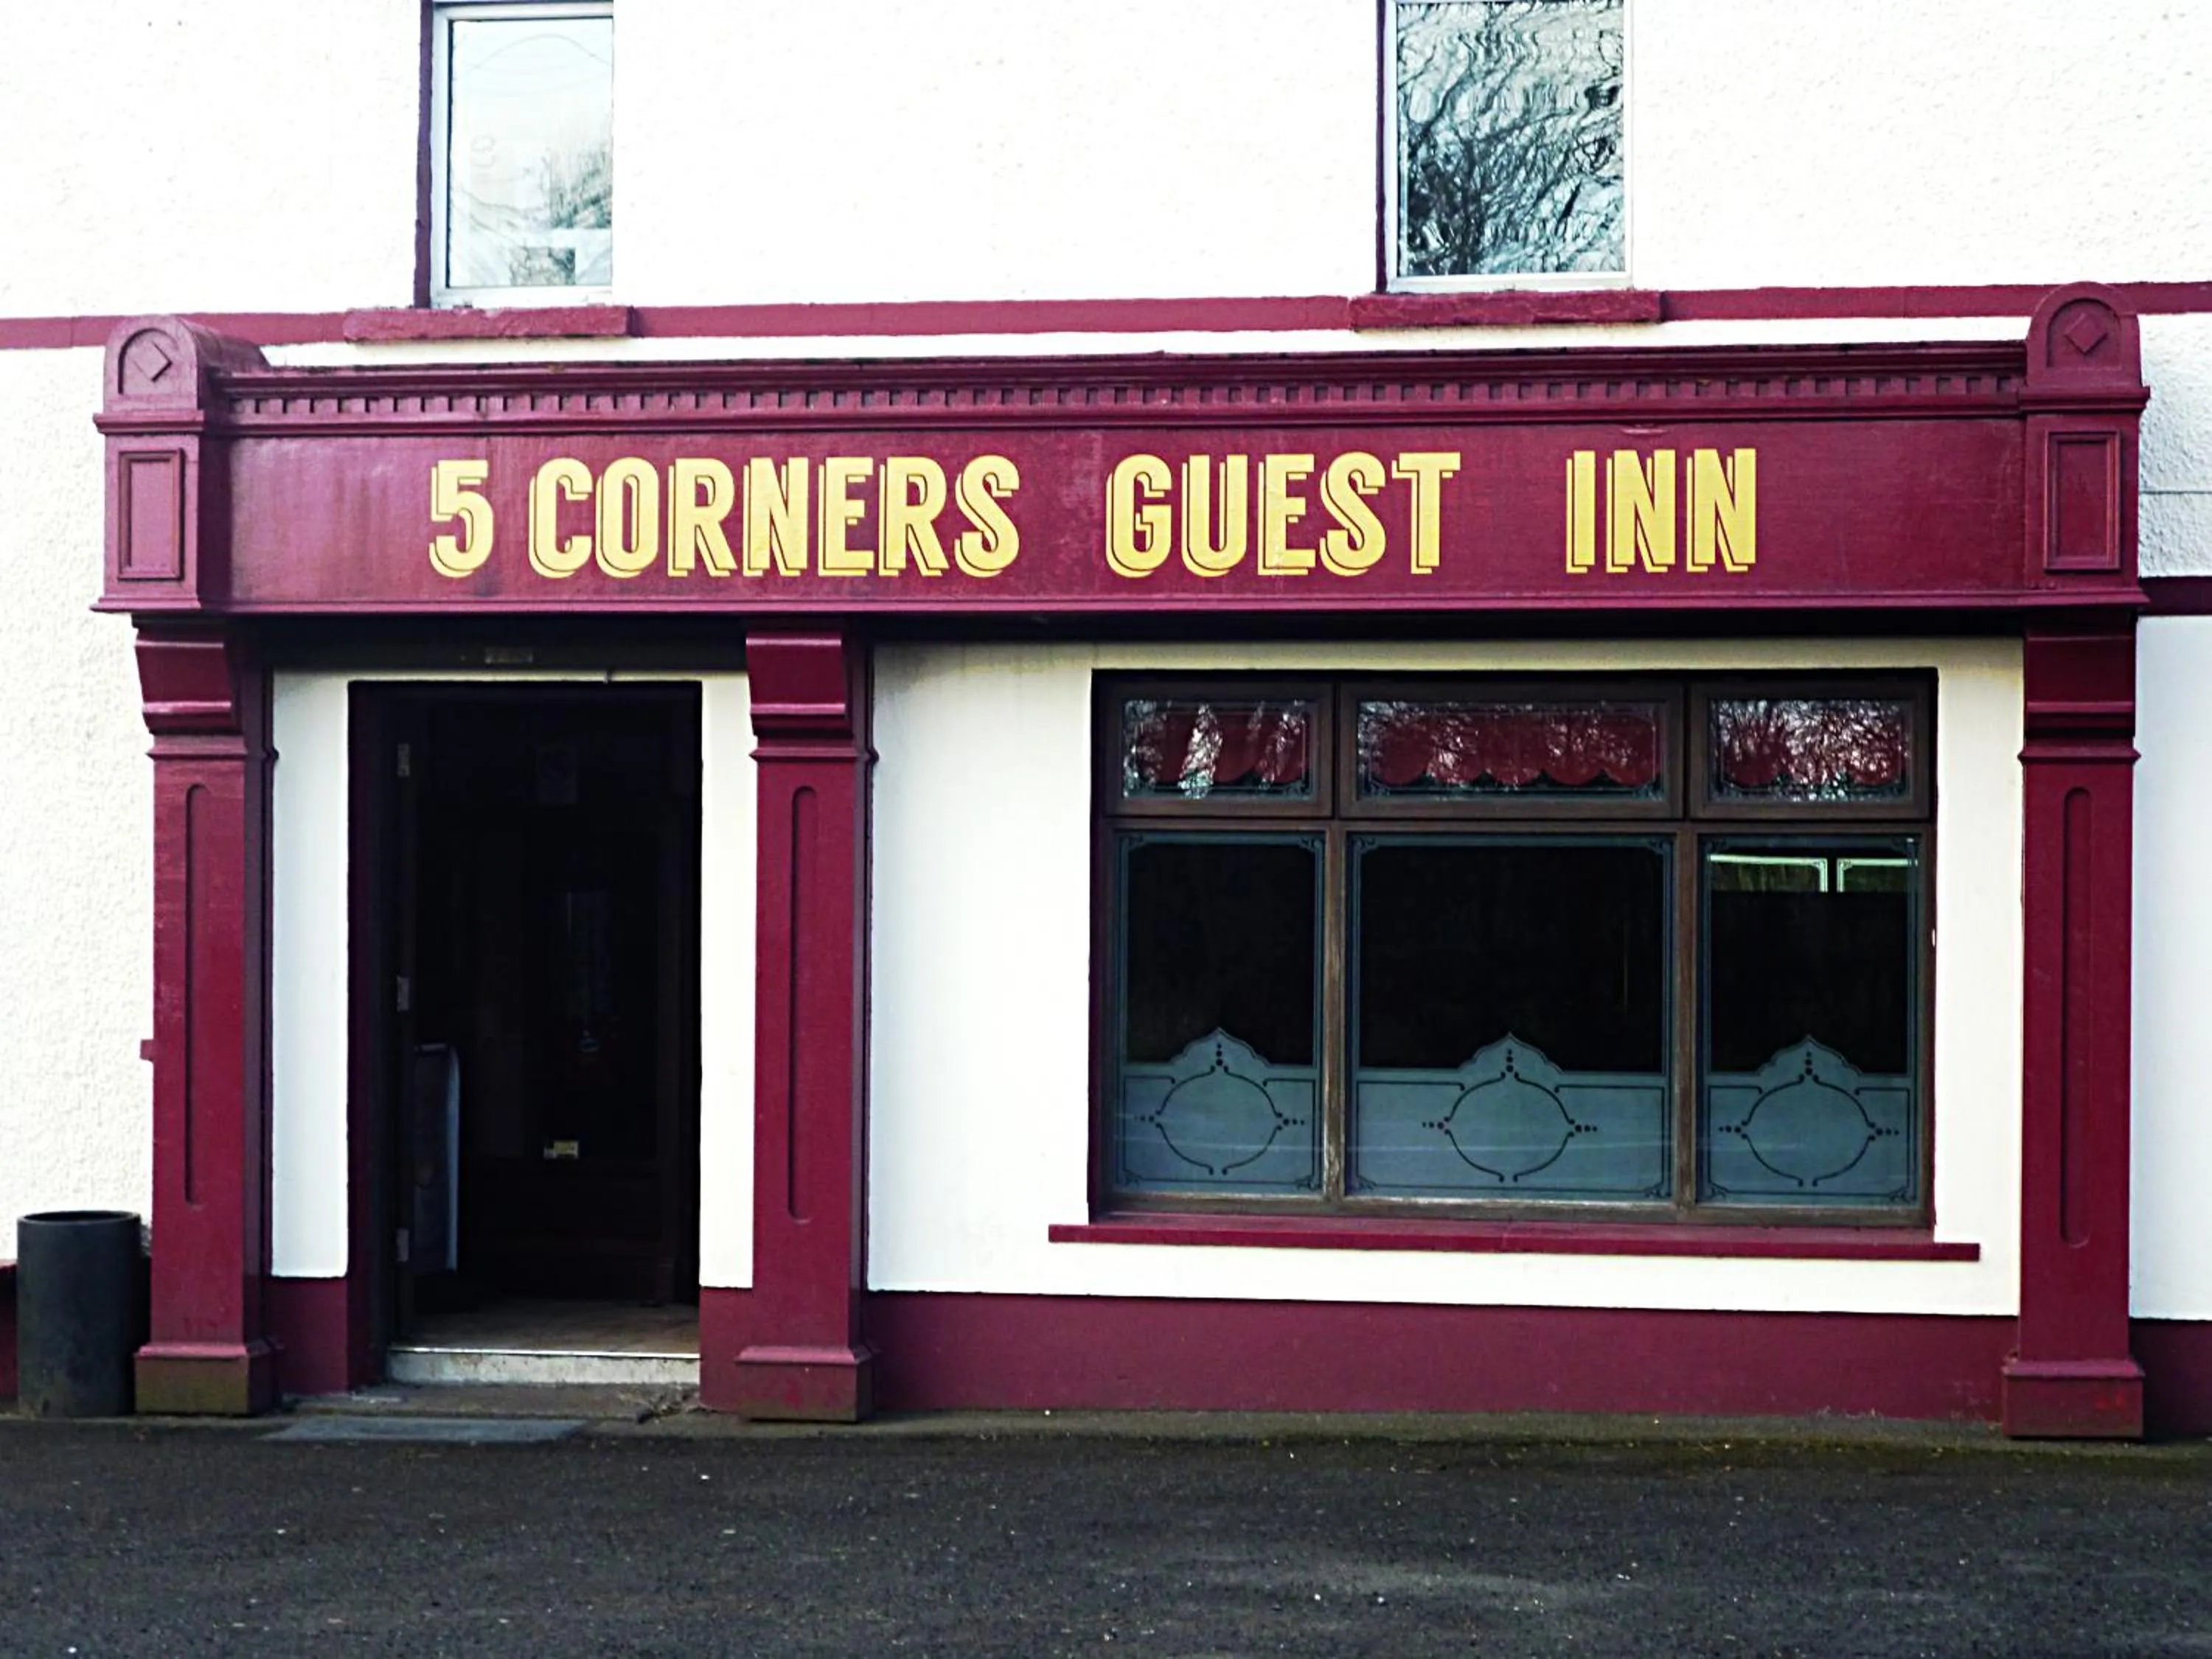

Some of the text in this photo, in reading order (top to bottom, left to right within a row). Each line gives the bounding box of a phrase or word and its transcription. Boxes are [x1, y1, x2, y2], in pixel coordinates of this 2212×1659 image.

[428, 447, 1757, 580] 5 CORNERS GUEST INN
